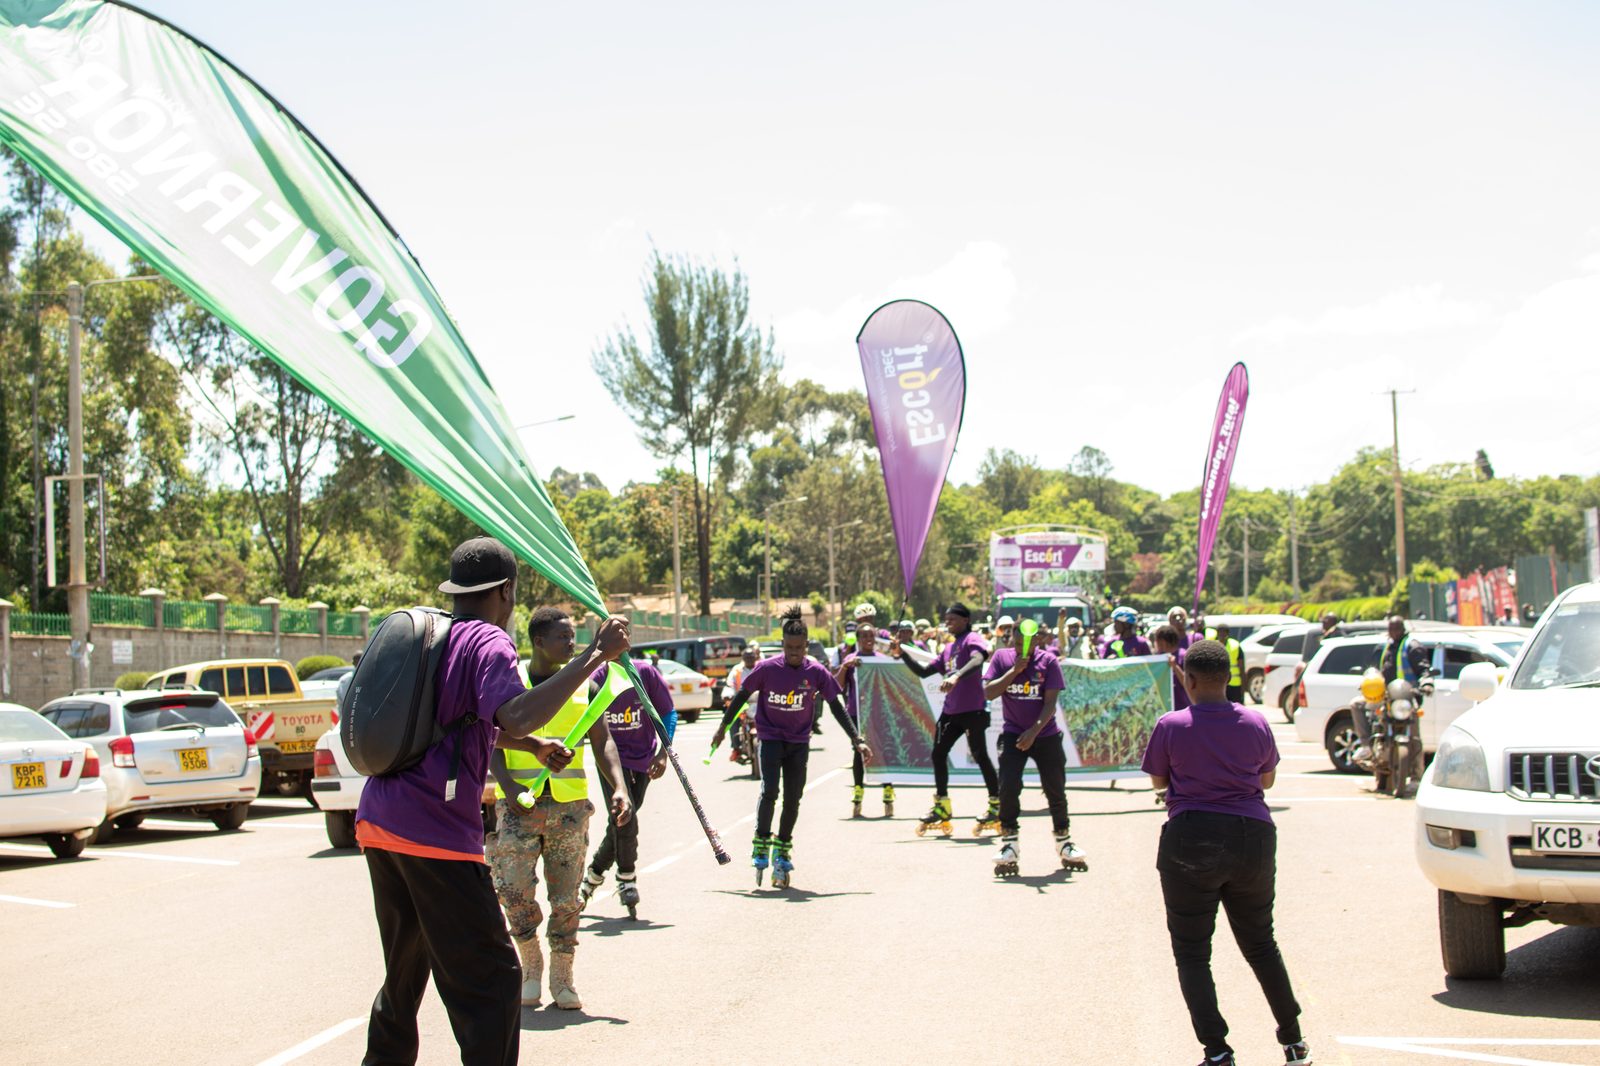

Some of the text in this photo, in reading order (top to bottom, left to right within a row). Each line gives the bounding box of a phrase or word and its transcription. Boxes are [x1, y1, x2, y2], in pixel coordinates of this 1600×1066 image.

[281, 714, 324, 726] TOYOTA
[180, 750, 200, 761] KCS
[15, 765, 37, 777] KBP
[17, 776, 45, 788] 721R
[1537, 826, 1583, 848] KCB
